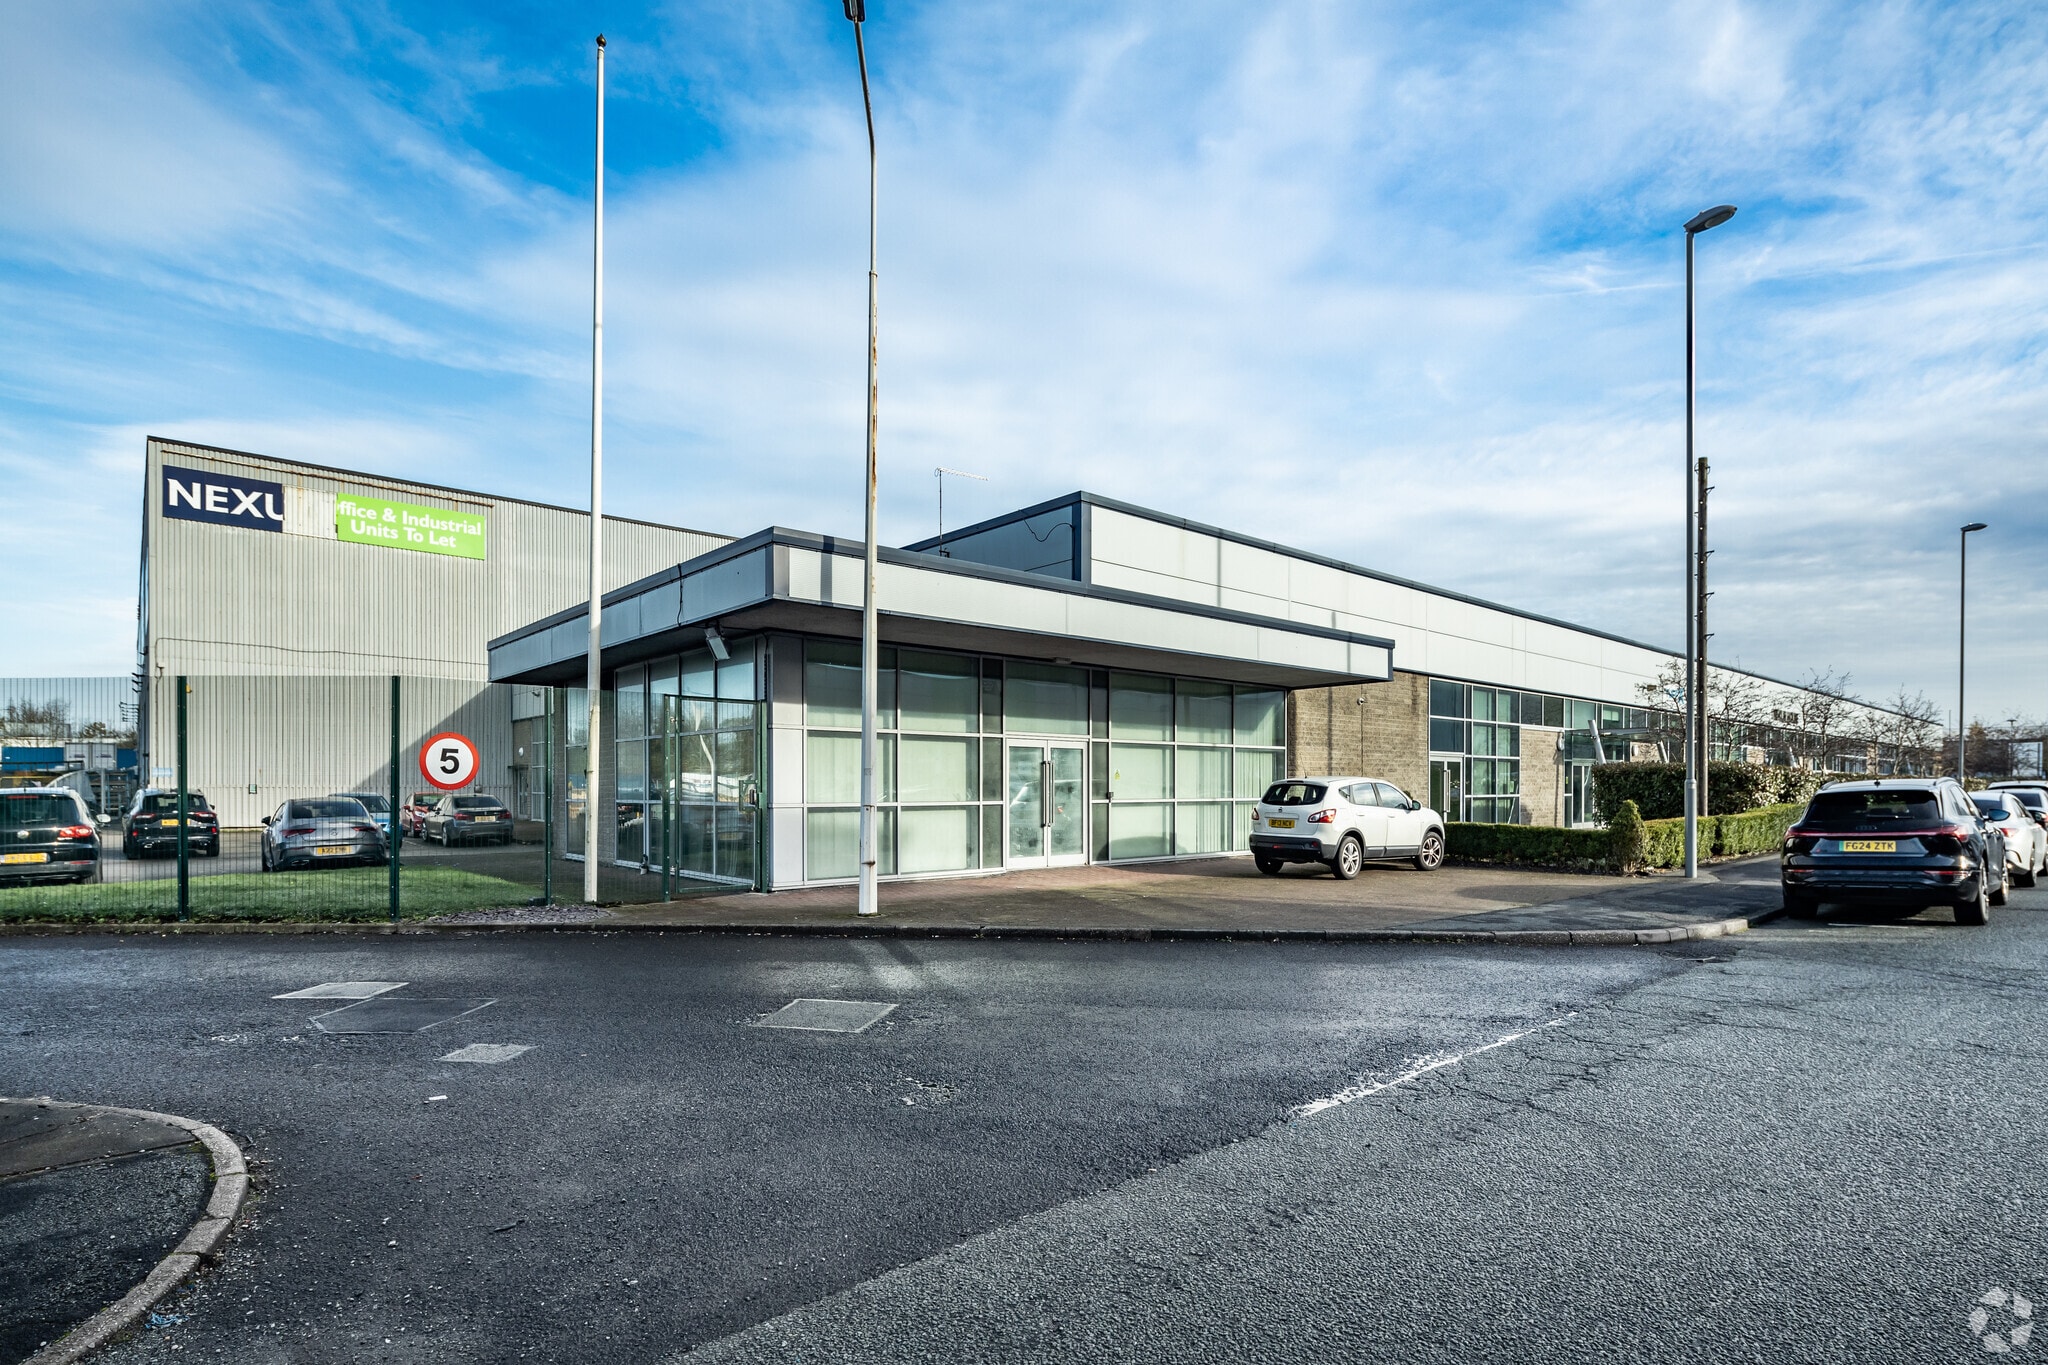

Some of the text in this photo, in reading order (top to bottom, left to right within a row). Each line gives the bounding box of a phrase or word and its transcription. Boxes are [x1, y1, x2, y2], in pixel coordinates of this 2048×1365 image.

[337, 500, 481, 536] ffice & Industrial
[350, 519, 456, 548] Units To Let
[440, 748, 460, 774] 5
[1845, 842, 1894, 850] FG24 ZTK
